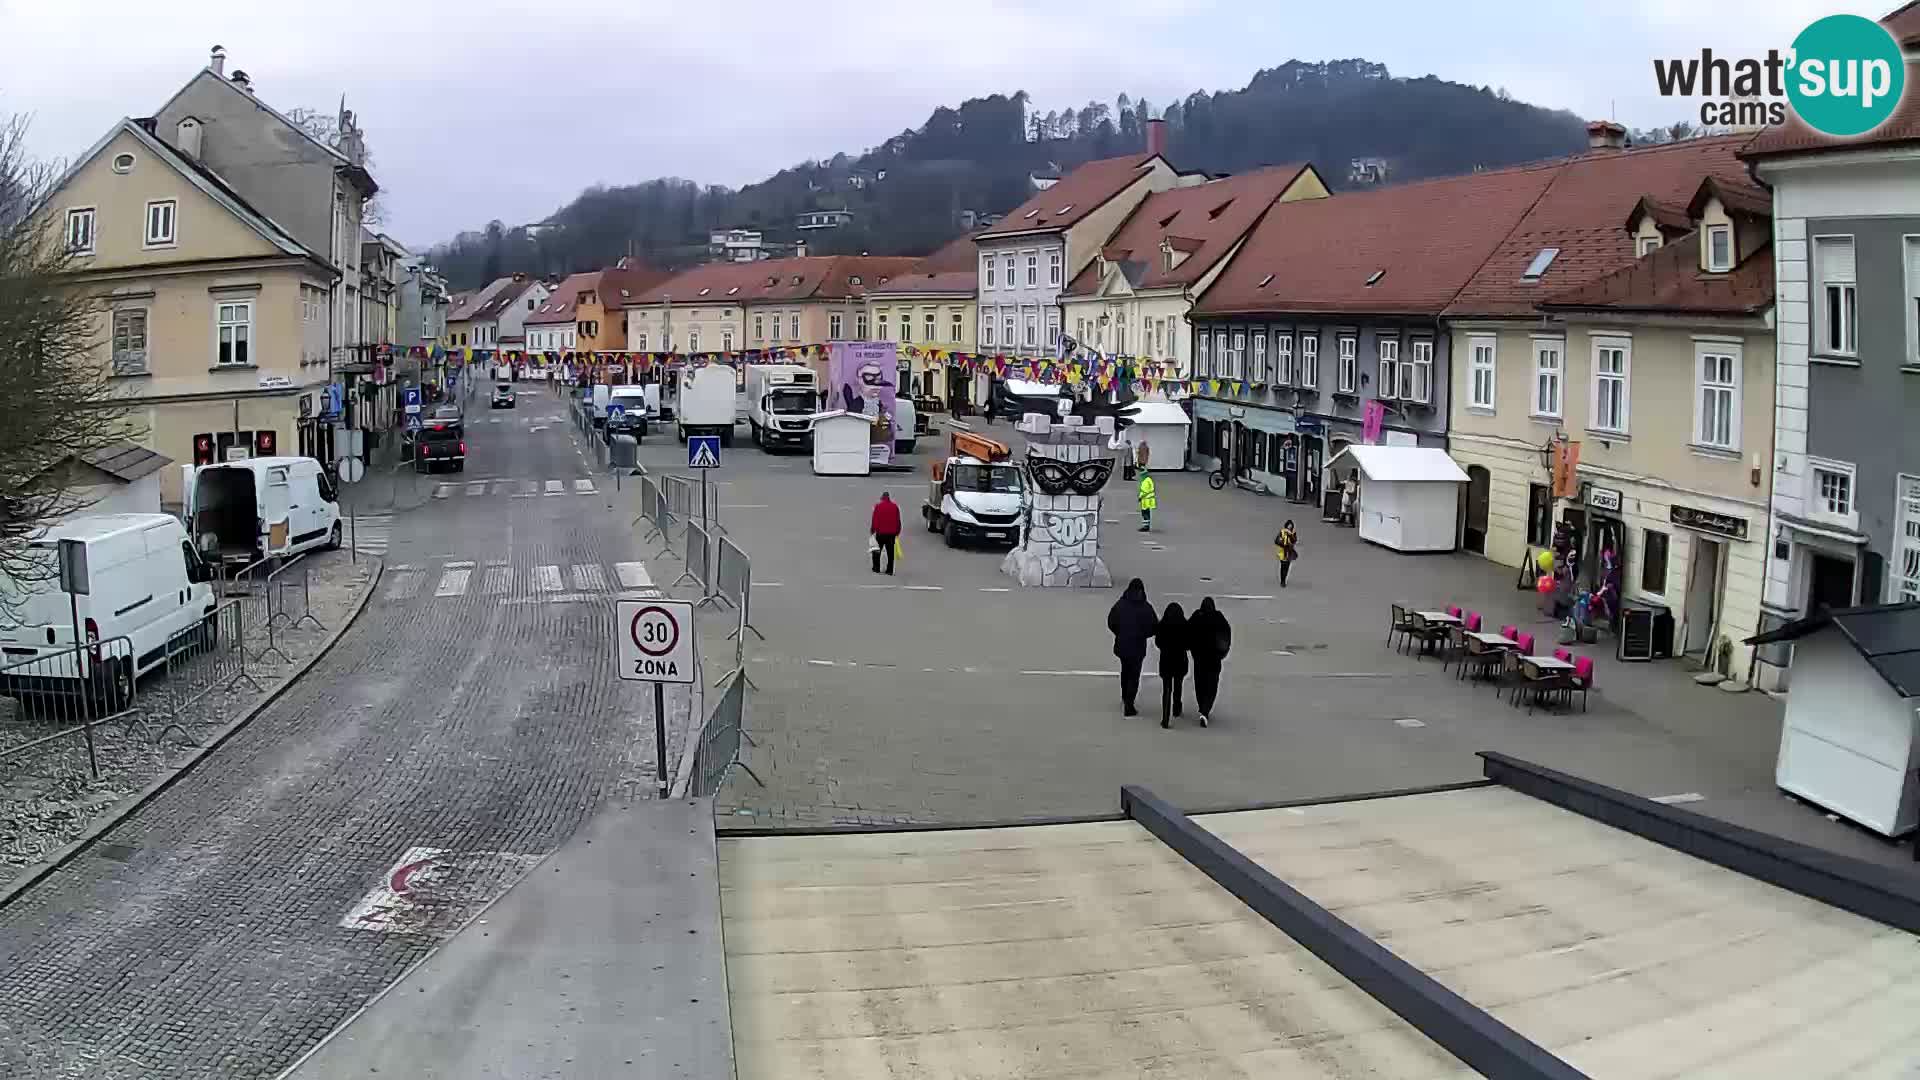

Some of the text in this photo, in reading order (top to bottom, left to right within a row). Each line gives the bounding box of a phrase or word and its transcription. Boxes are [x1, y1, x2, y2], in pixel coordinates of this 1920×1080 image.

[408, 391, 417, 403] P
[643, 622, 668, 643] 30
[634, 659, 678, 676] ZONA
